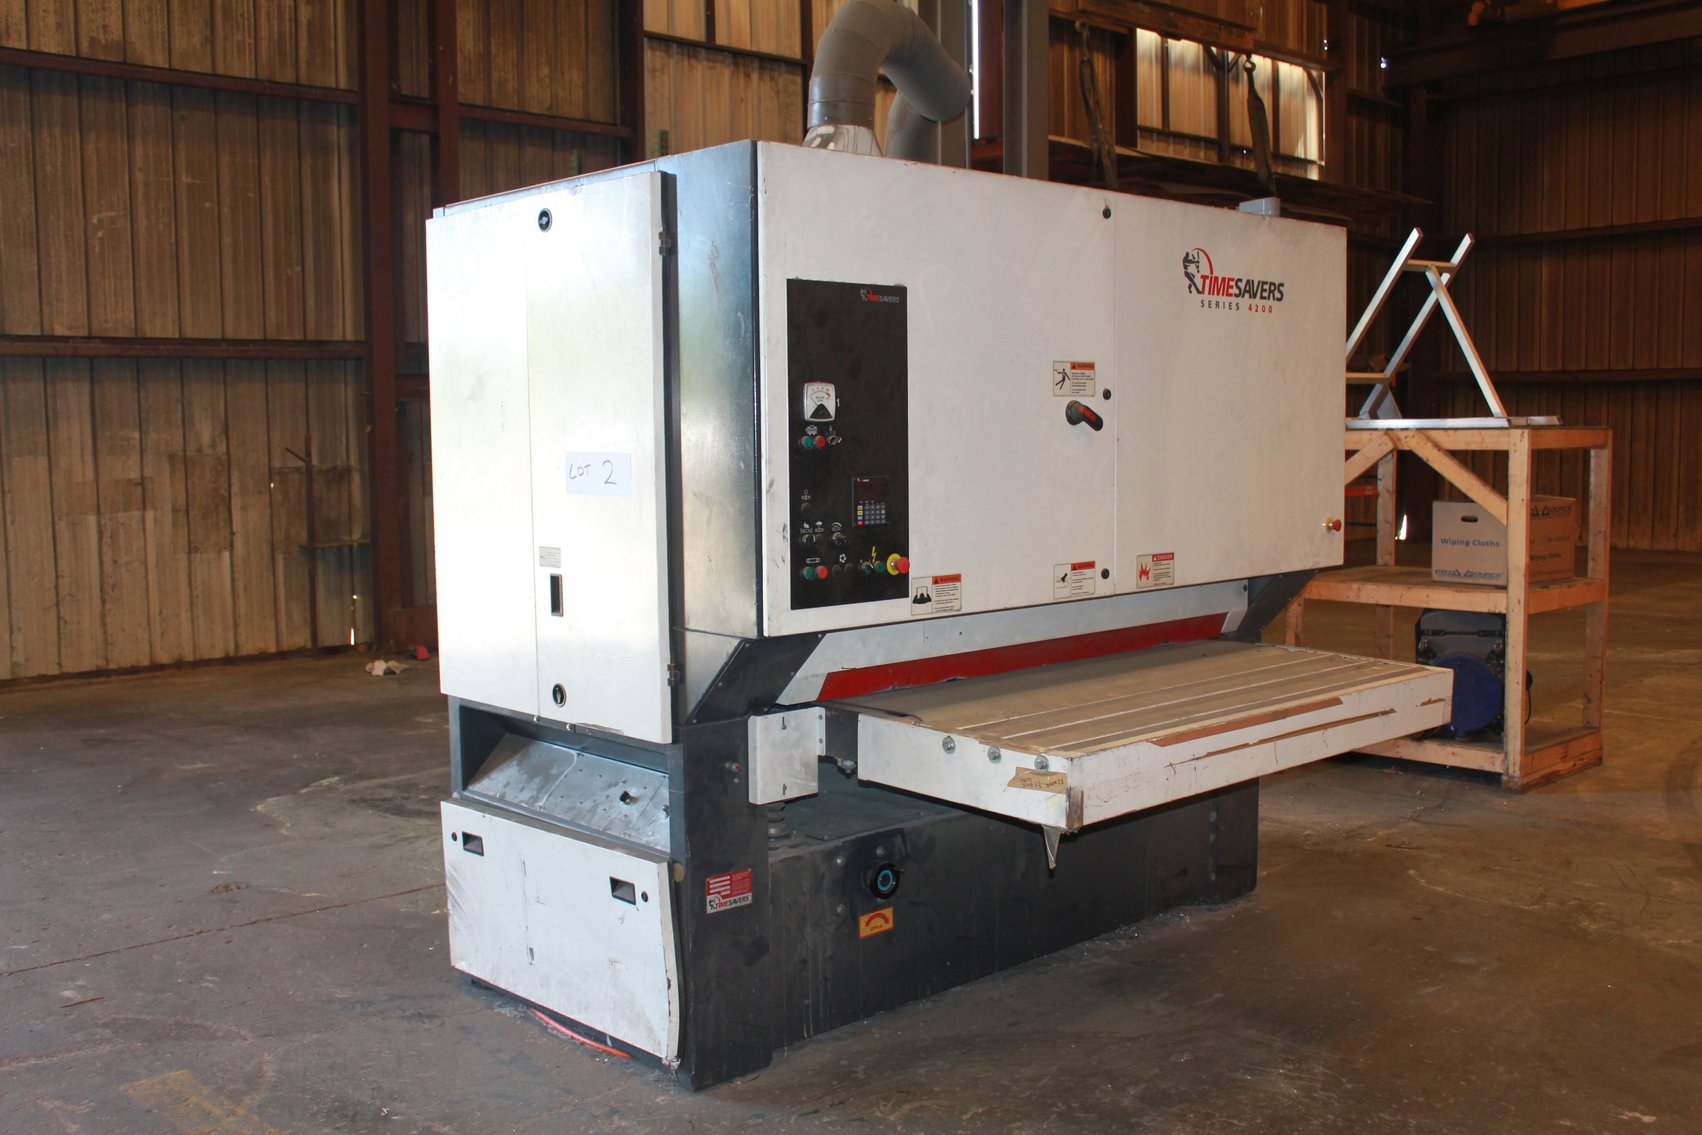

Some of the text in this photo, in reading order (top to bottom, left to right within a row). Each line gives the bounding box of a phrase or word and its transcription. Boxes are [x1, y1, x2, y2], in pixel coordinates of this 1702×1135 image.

[1200, 275, 1285, 302] TIMESAVERS
[1200, 299, 1273, 314] SERIES 4200
[569, 460, 618, 485] LOT 2
[1440, 537, 1500, 548] Wiping Cloths
